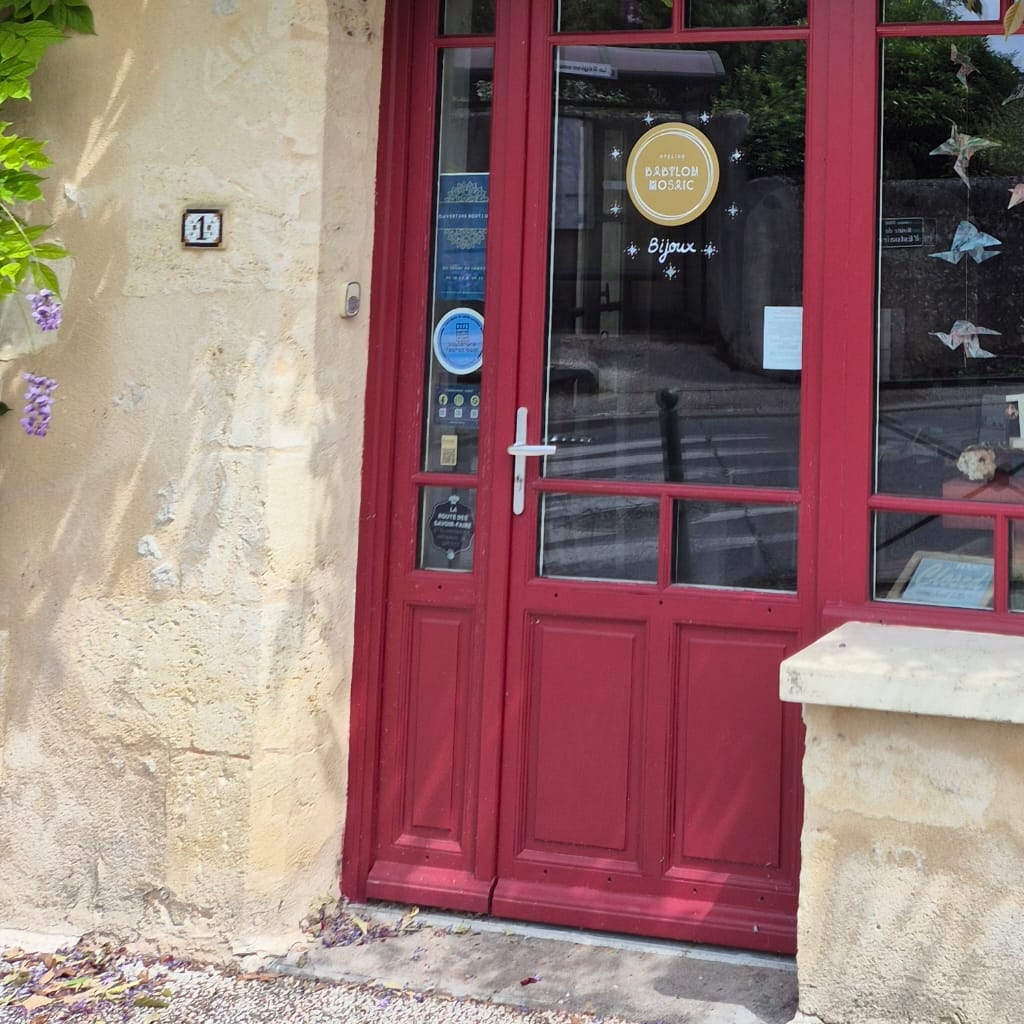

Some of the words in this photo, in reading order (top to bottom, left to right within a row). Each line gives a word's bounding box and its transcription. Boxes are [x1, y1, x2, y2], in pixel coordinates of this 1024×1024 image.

[644, 166, 699, 177] BABYLON
[648, 179, 695, 191] MOSAIC
[196, 215, 208, 241] 1
[647, 237, 697, 264] Bijoux
